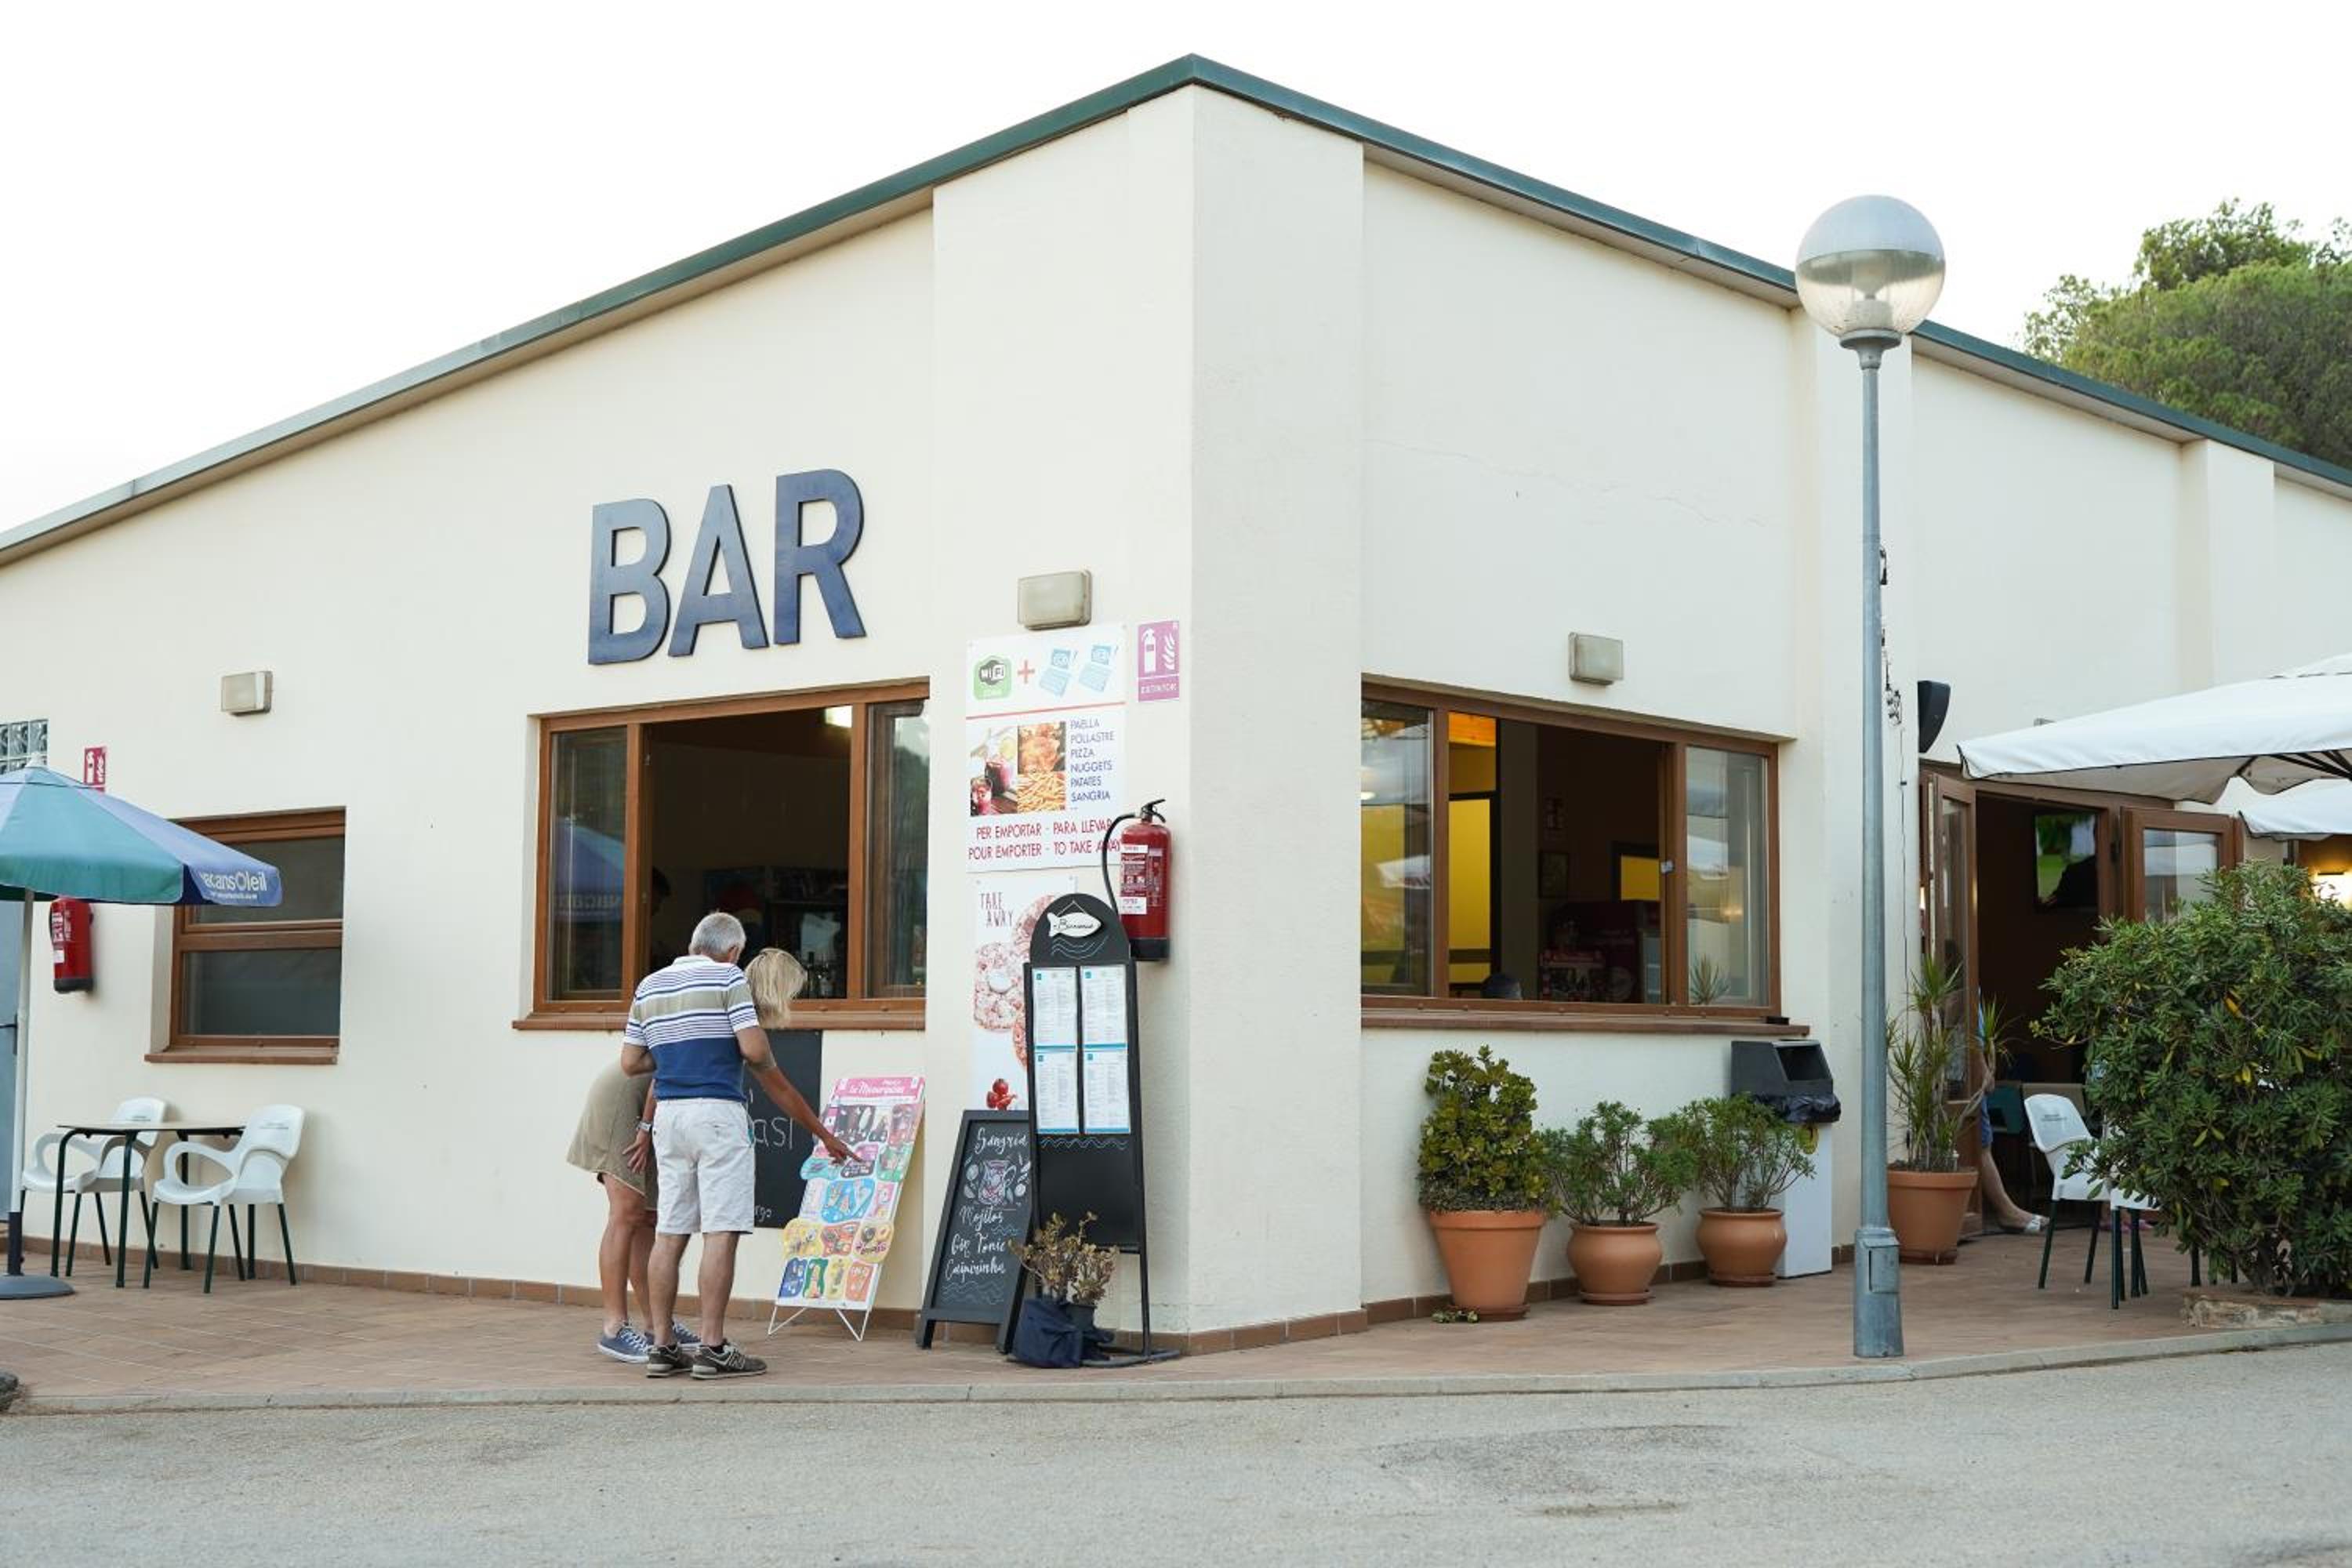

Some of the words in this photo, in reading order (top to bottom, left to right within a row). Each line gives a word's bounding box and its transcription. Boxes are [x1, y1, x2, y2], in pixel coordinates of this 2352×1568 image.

[588, 468, 867, 665] BAR
[1070, 719, 1099, 729] PAELLA
[1070, 731, 1115, 744] POLLASTRE
[1070, 748, 1094, 758] PIZZA
[1070, 760, 1112, 772] NUGGETS
[1070, 776, 1101, 787] PATATES
[1070, 790, 1110, 801] SANGRIA
[977, 826, 991, 840] PER
[996, 822, 1041, 838] EMPORTAR
[1053, 821, 1077, 834] PARA
[969, 846, 992, 860] POUR
[996, 843, 1041, 858] EMPORTER
[1054, 840, 1066, 855] TO
[1070, 840, 1092, 854] TAKE
[979, 891, 1004, 910] TAKE
[985, 909, 1014, 927] AWAY
[975, 1127, 1027, 1155] Sangria
